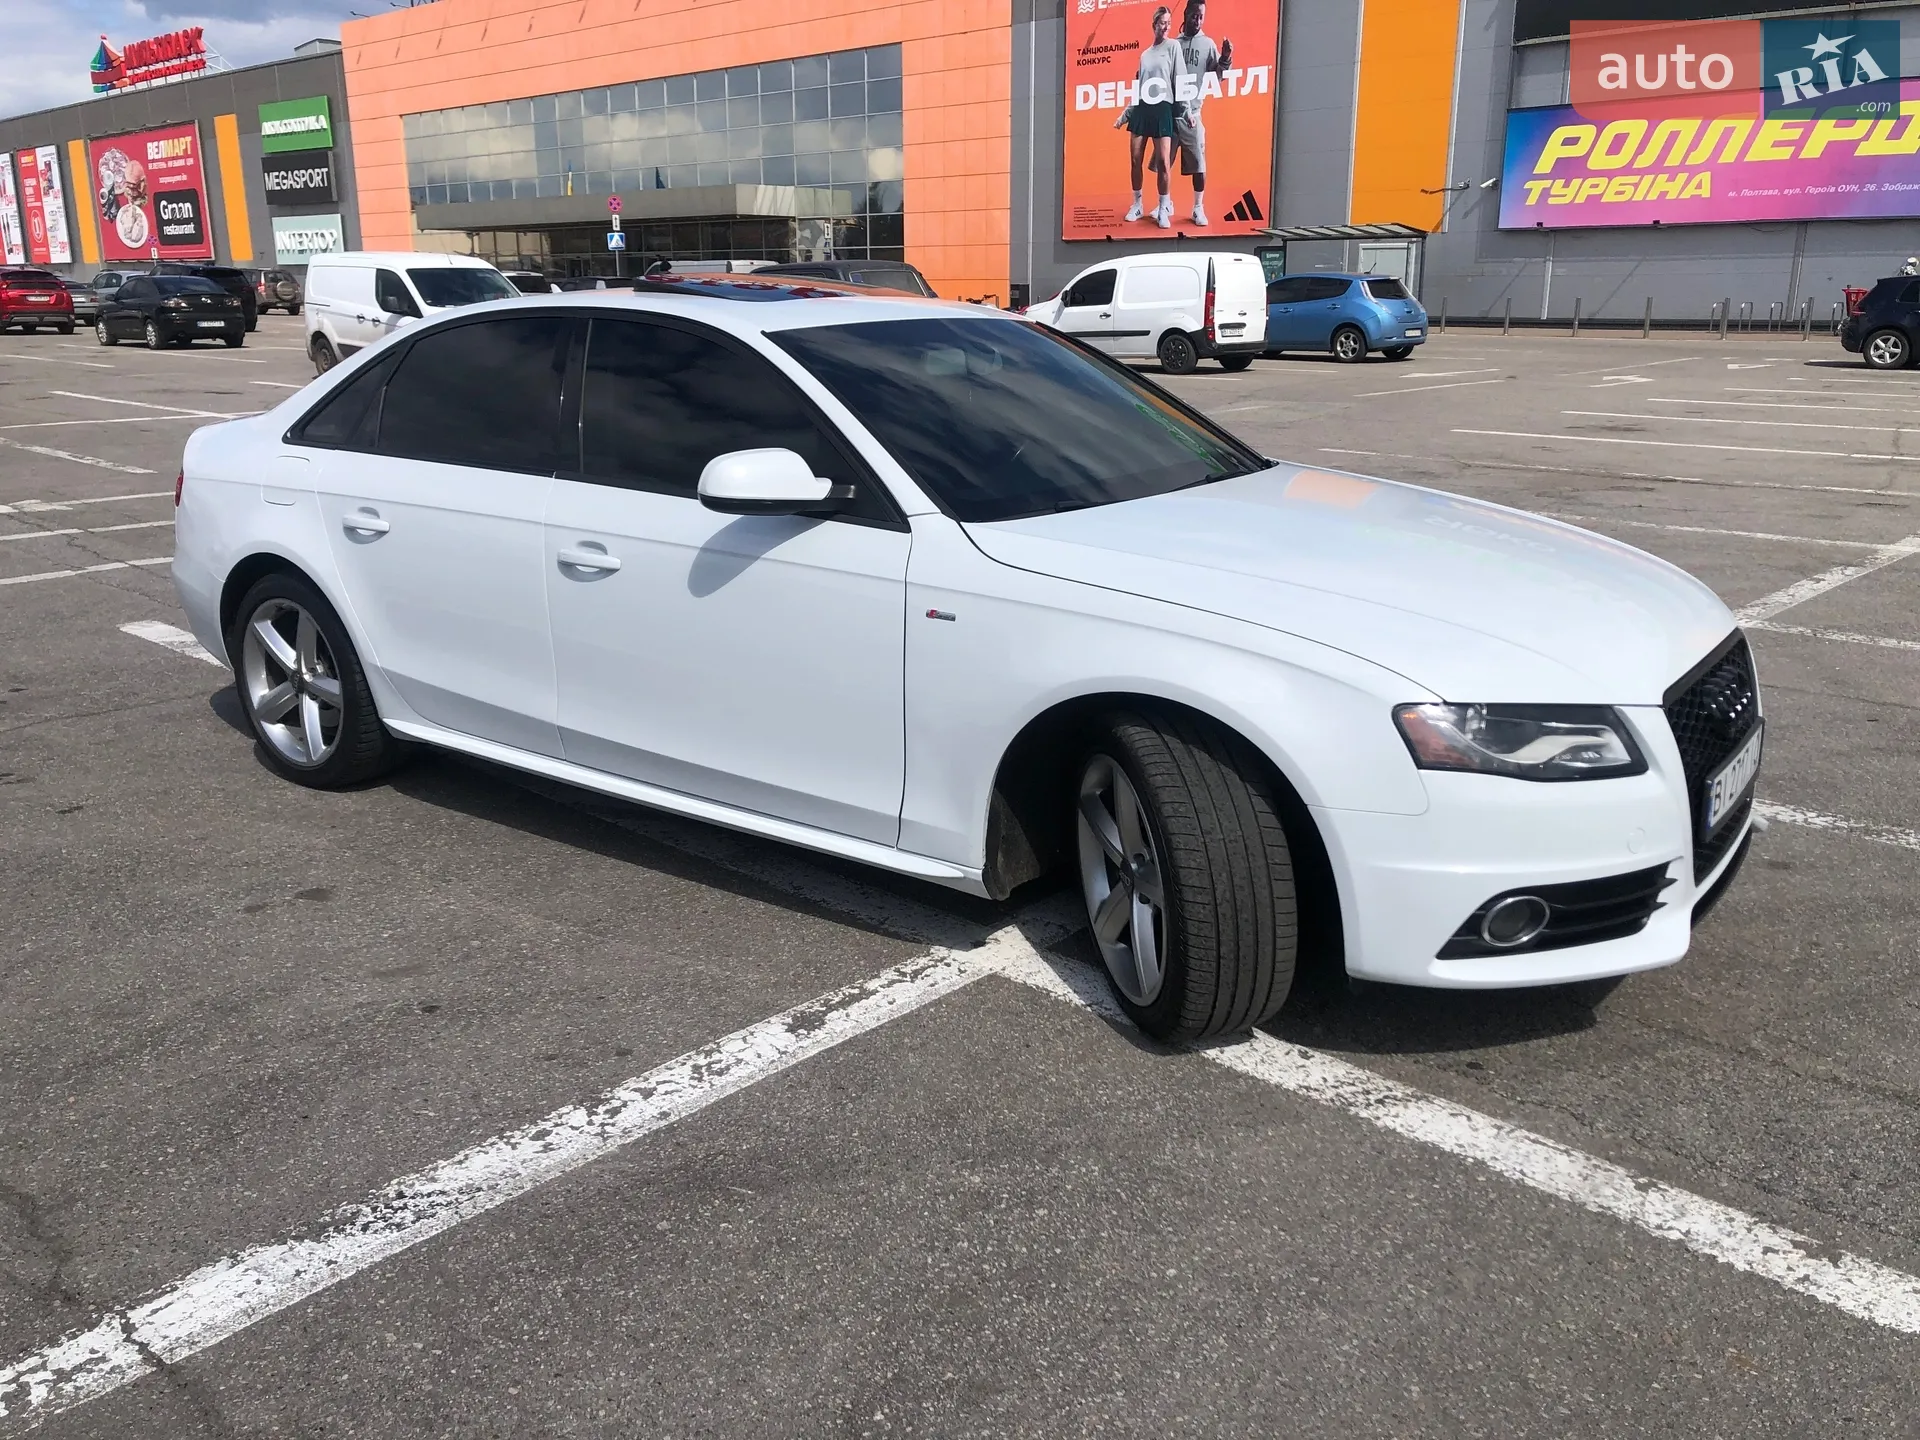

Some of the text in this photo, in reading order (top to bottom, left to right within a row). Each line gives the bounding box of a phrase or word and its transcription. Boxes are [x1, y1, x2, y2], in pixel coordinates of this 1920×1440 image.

[1077, 40, 1140, 56] ТАНЦЮВАЛЬНИЙ
[1077, 56, 1112, 67] КОНКУРС
[147, 136, 192, 160] ВЕЛМАРТ
[265, 168, 329, 191] MEGASPORT
[1524, 171, 1711, 206] ТУРБІНА
[1740, 188, 1781, 198] Полтава,
[1783, 188, 1802, 196] вул.
[1804, 184, 1836, 195] Героїв
[1837, 184, 1860, 194] ОУН,
[1863, 183, 1879, 192] 26.
[163, 221, 196, 236] restaurant
[275, 228, 338, 251] INTERTOP
